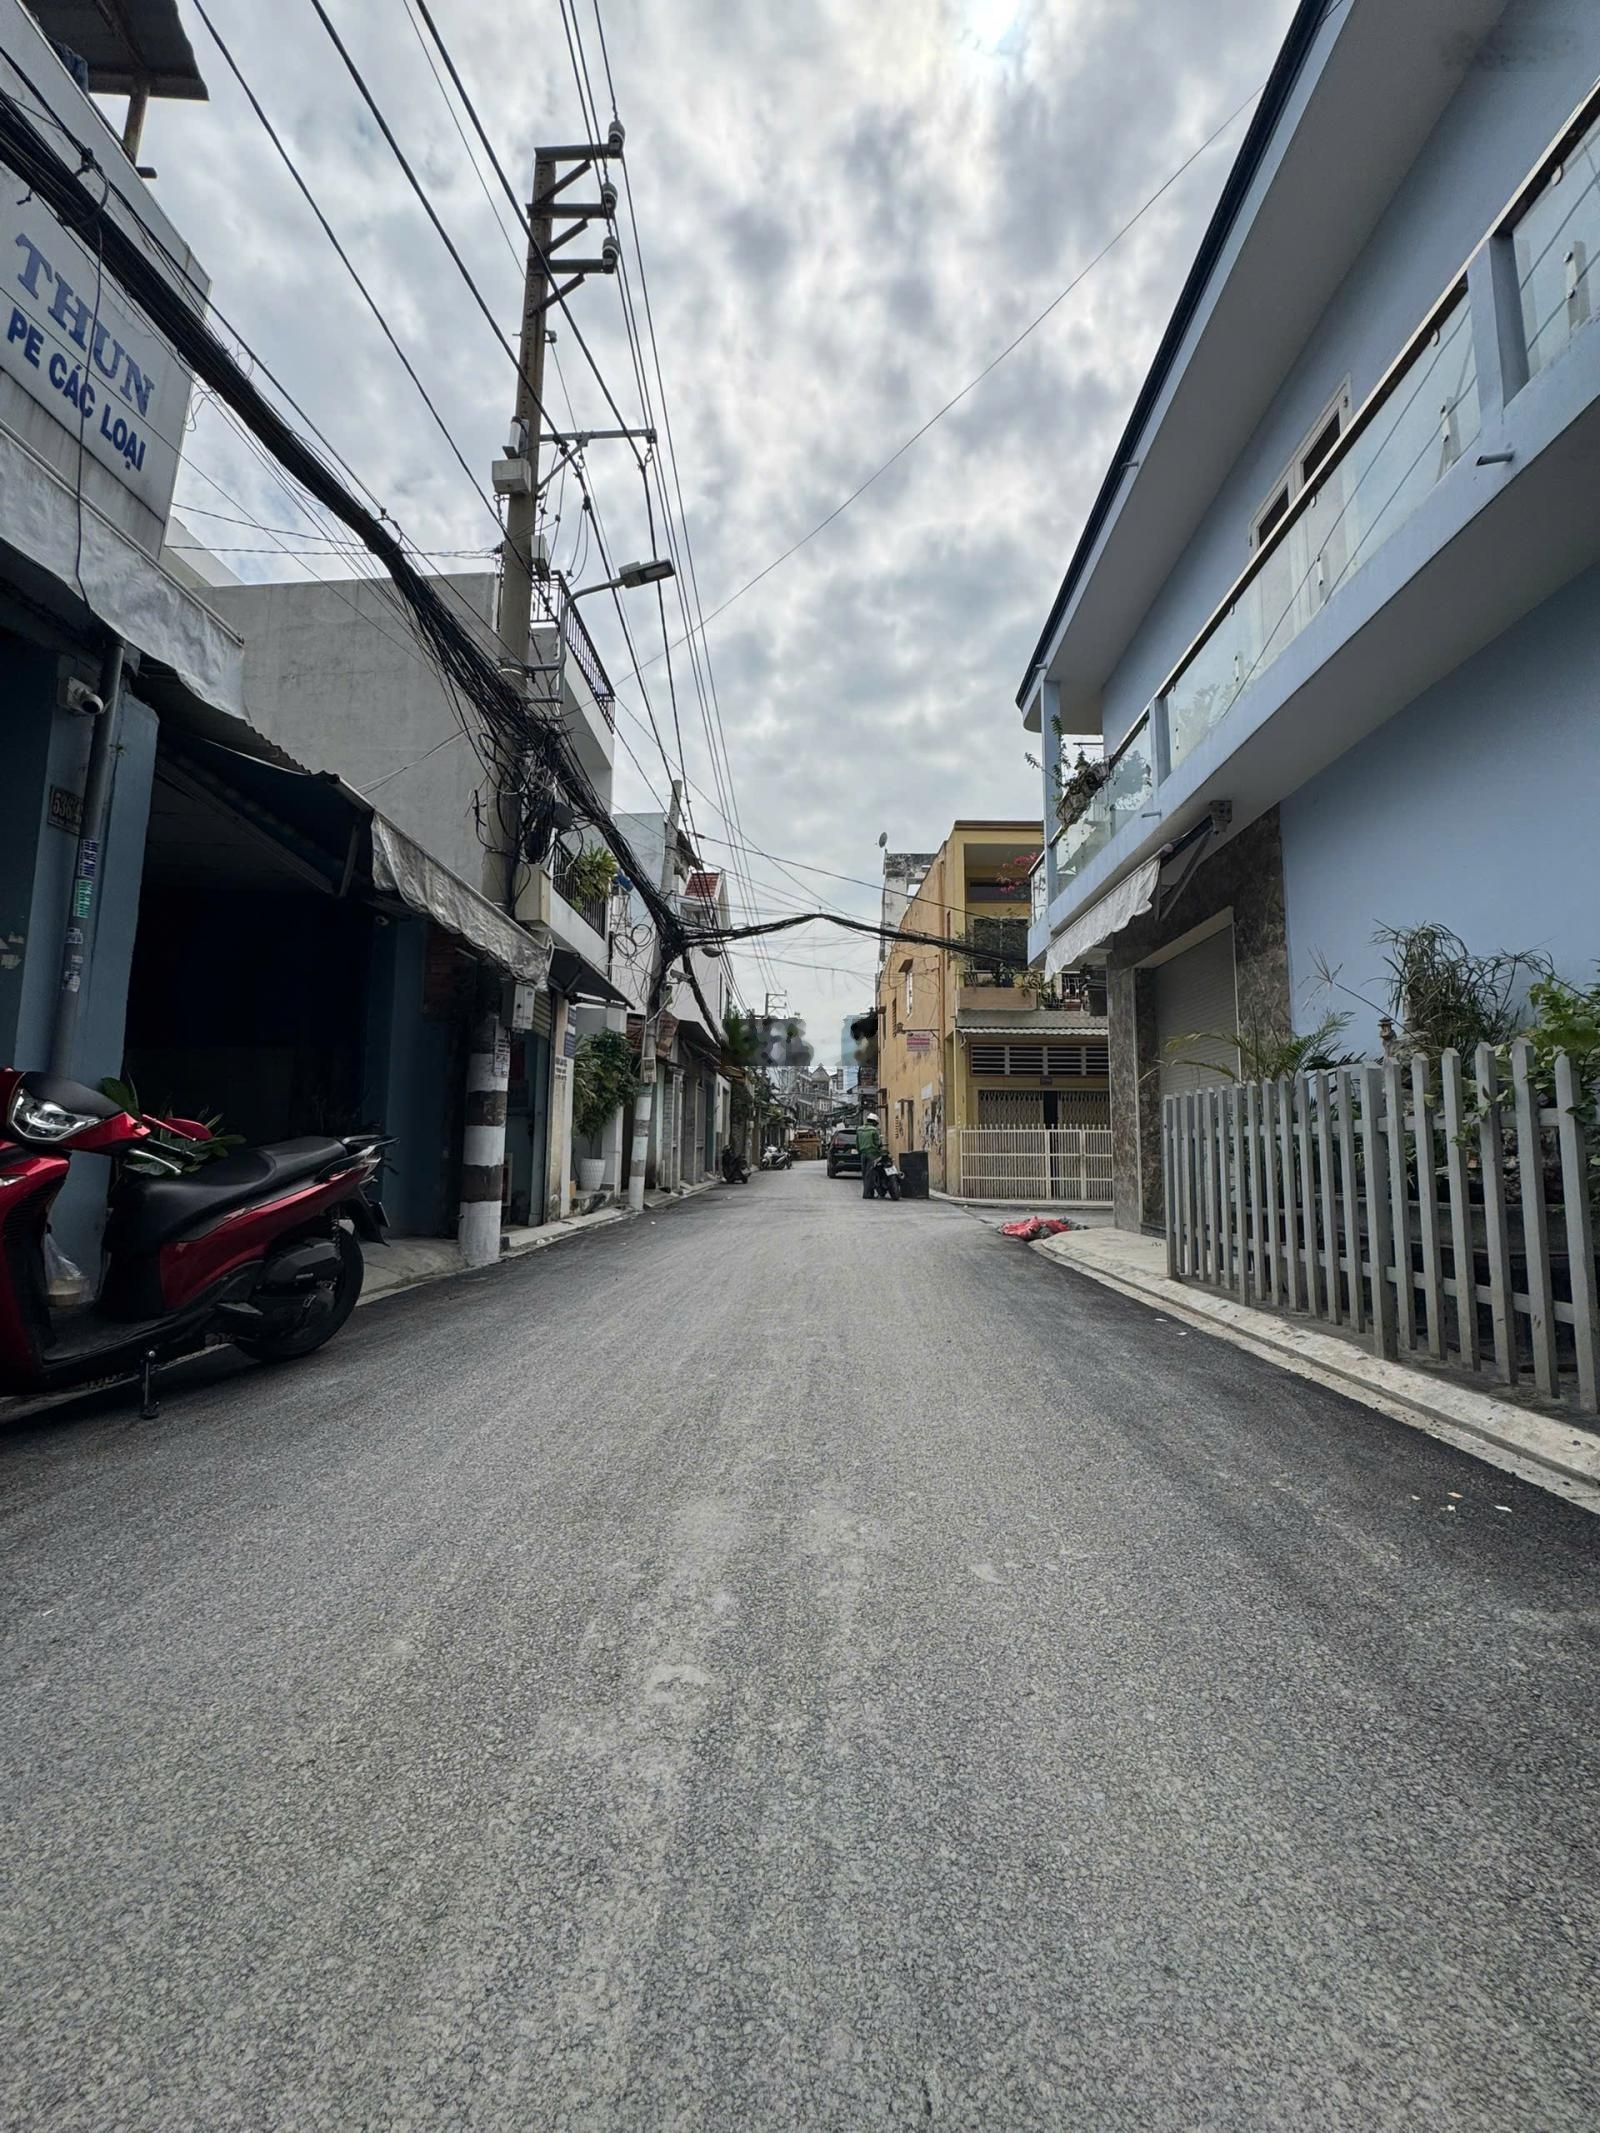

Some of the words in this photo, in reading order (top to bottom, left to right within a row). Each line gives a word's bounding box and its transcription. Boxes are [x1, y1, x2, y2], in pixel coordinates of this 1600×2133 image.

[7, 307, 44, 368] PE
[49, 352, 95, 418] CÁC
[100, 404, 147, 472] LOẠI
[16, 234, 155, 417] THUN
